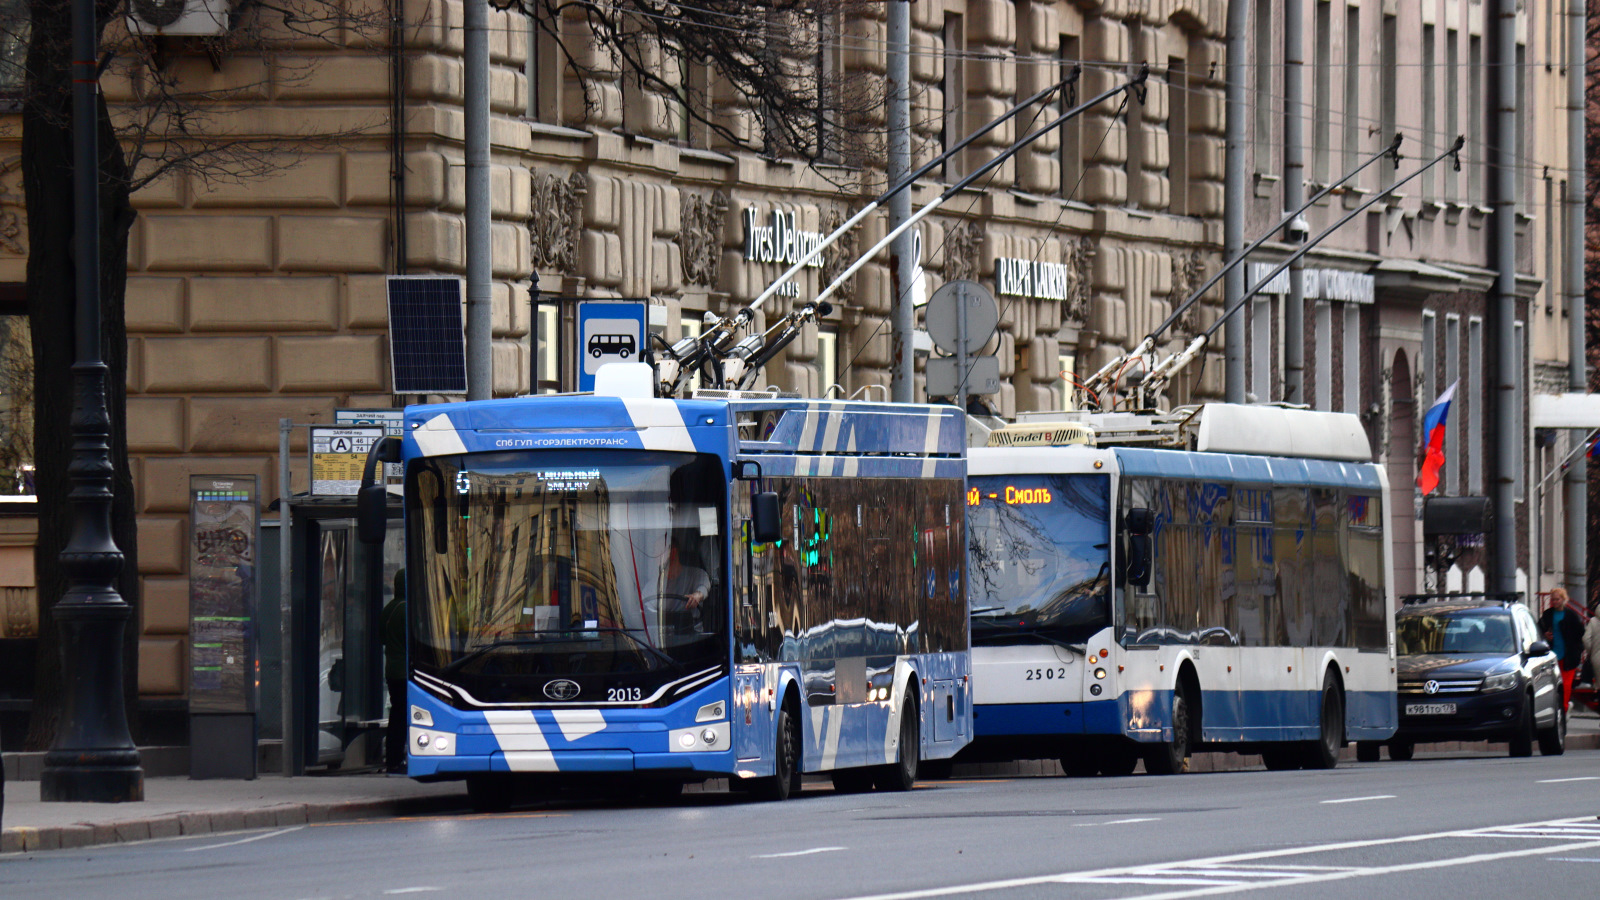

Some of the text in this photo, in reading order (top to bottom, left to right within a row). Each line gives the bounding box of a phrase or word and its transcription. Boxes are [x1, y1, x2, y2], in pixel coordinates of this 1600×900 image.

[748, 207, 825, 268] Yves Delorme
[1001, 257, 1067, 301] RALPH LAUREN
[495, 439, 513, 447] СПб
[534, 438, 628, 446] «ГОРЭЛЕКТРОТРАНС»
[1013, 432, 1052, 442] indel B
[1026, 668, 1065, 681] 2502
[607, 687, 642, 702] 2013
